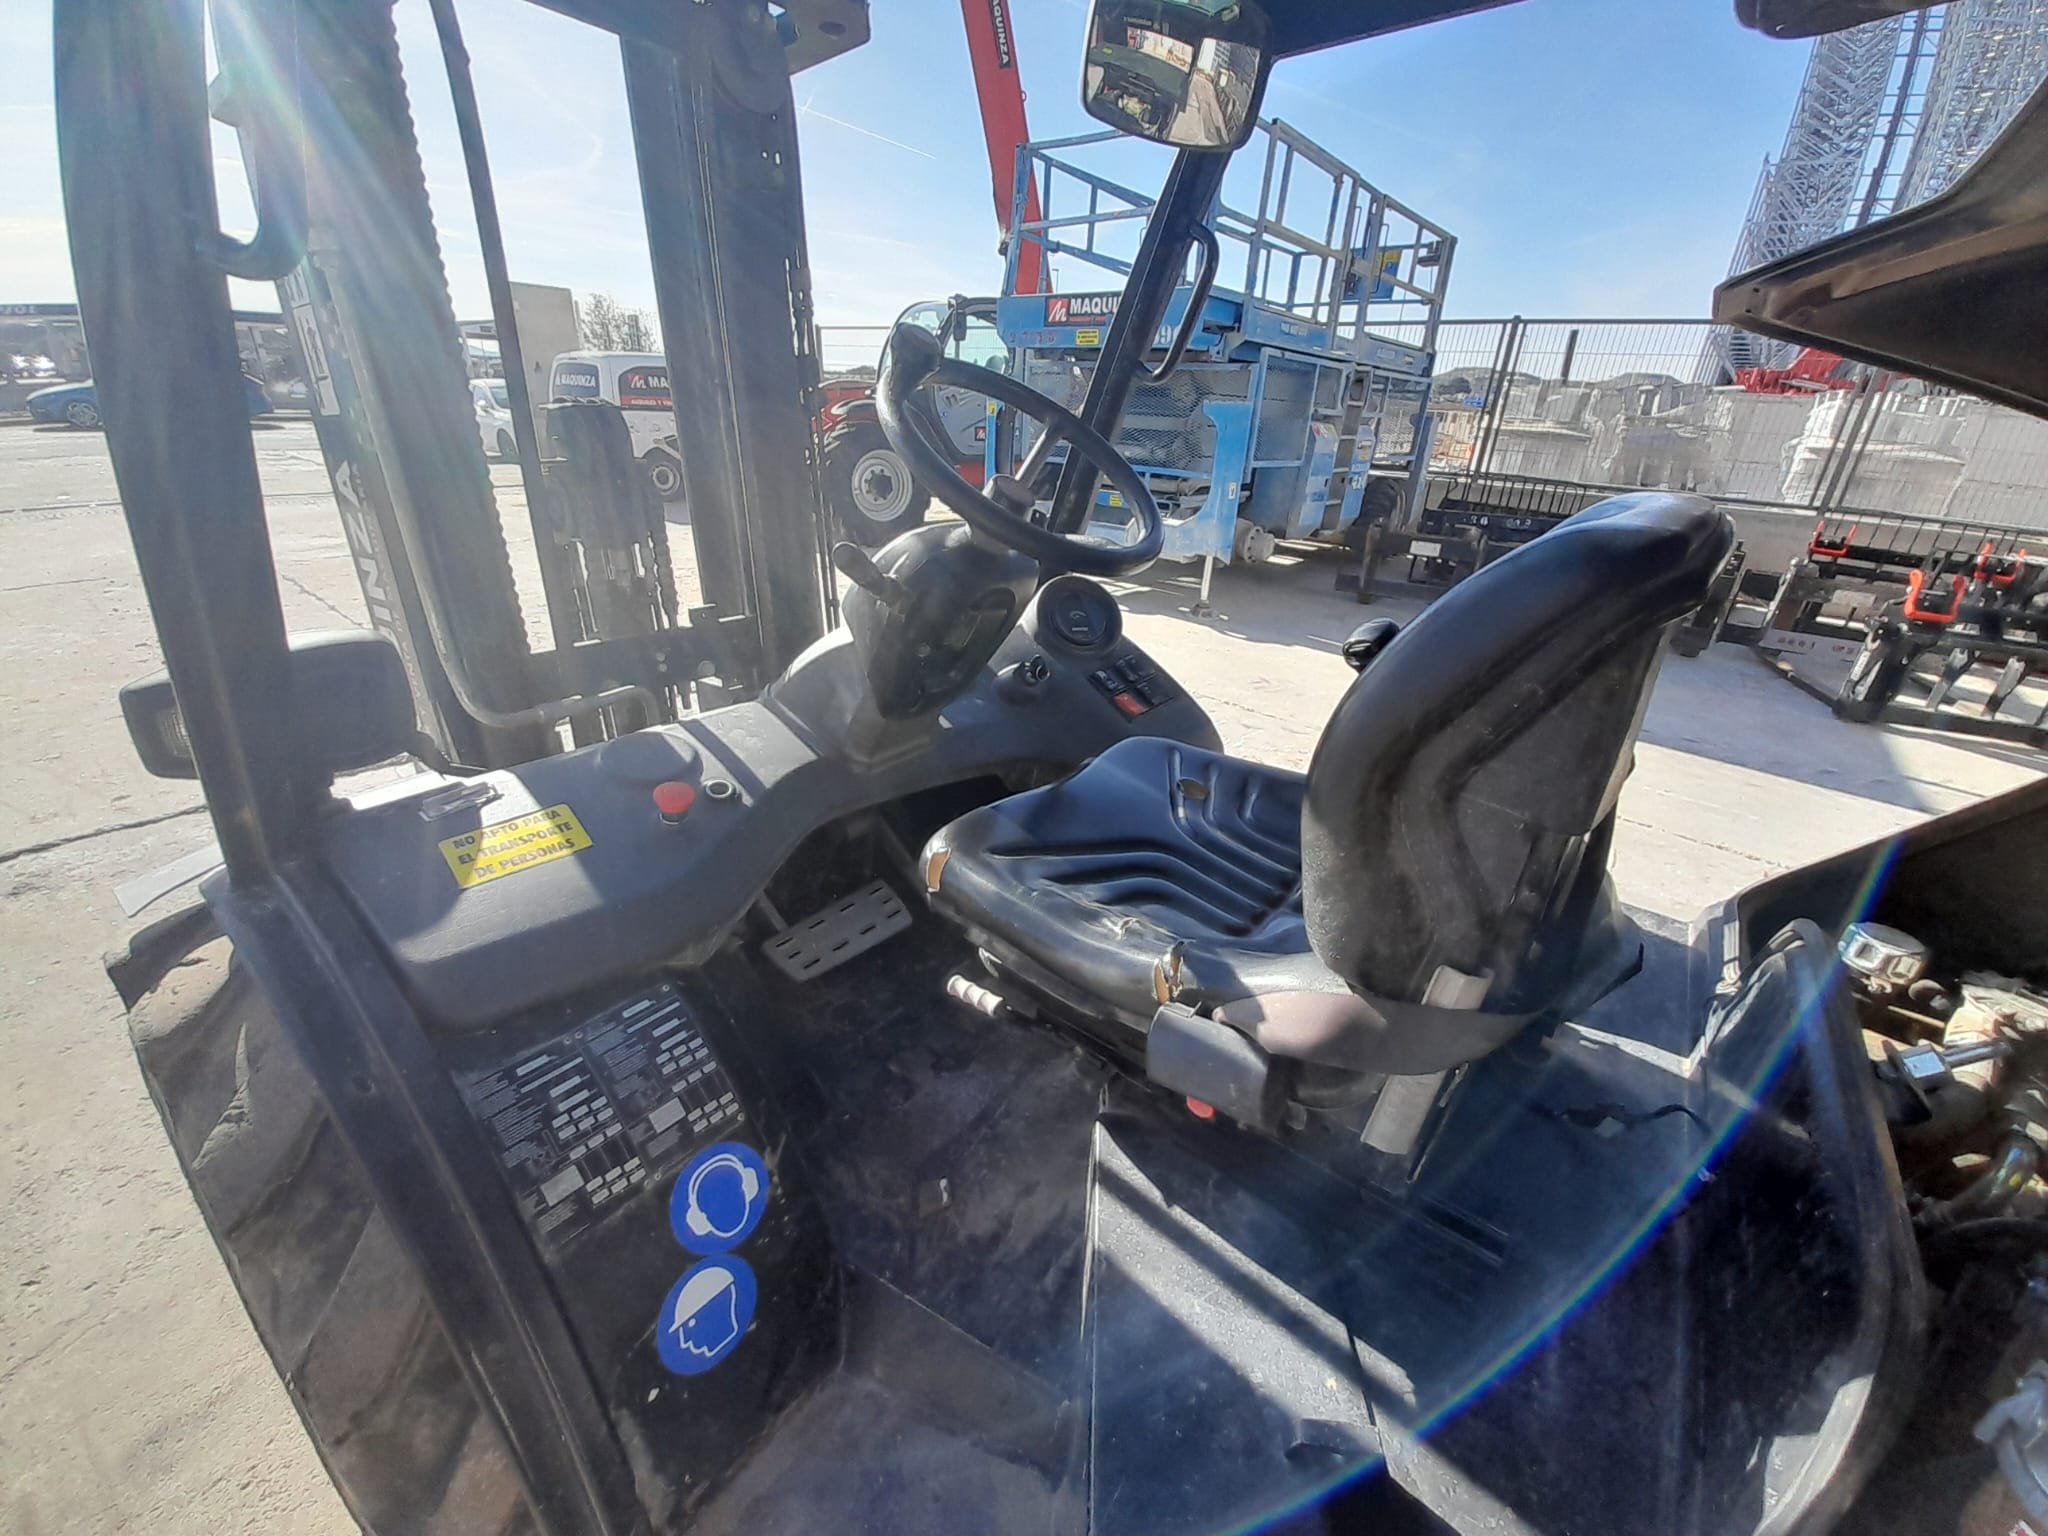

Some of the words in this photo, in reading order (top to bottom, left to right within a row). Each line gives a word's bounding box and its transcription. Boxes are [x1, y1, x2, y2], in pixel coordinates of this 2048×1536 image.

[453, 835, 476, 849] NO
[482, 822, 520, 840] APTO
[522, 809, 561, 827] PARA
[457, 853, 475, 865] EL
[479, 821, 573, 858] TRANSPORTE
[474, 863, 496, 878] DE
[500, 838, 576, 870] PERSONAS
